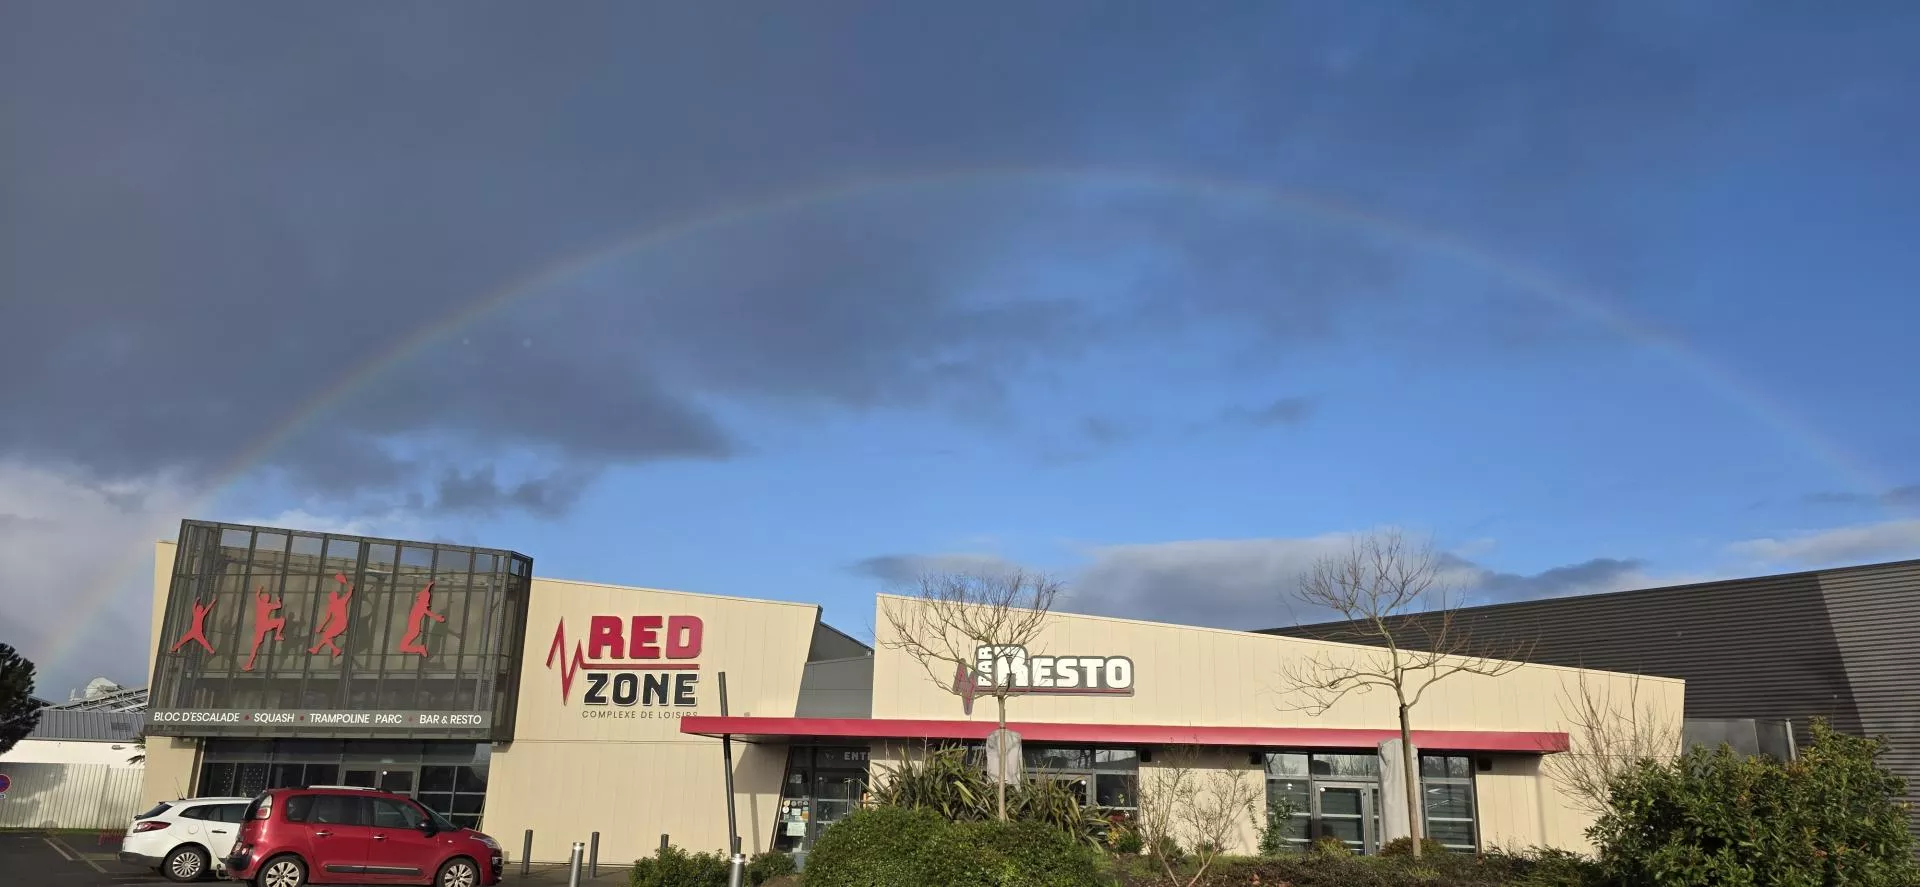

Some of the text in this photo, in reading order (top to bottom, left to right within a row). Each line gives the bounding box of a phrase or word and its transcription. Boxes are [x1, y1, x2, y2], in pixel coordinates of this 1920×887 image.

[588, 615, 703, 659] RED
[977, 646, 993, 687] BAR
[994, 645, 1132, 689] RESTO
[584, 673, 698, 706] ZONE
[153, 711, 482, 725] BLOC D'ESCALADE SQUASH TRAMPOLINE PARC BAR & RESTO
[582, 710, 636, 719] COMPLEXE
[641, 711, 654, 719] DE
[844, 751, 870, 761] ENT
